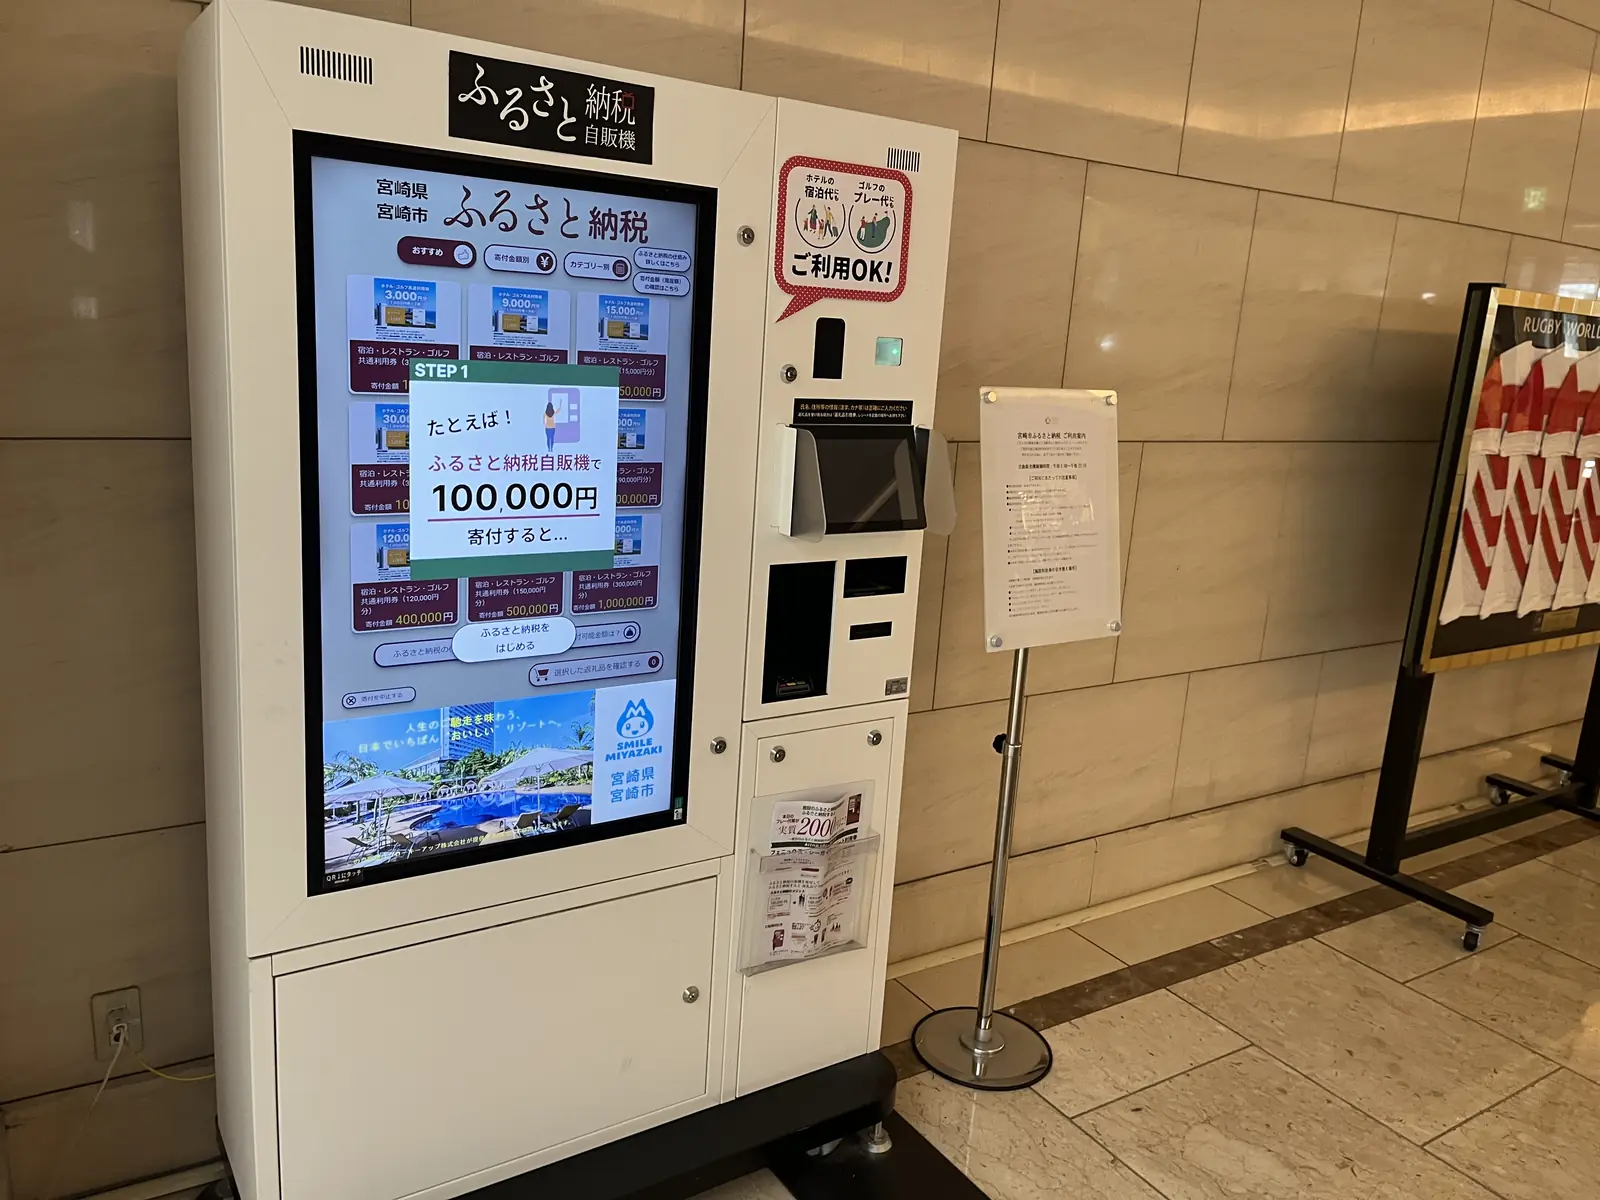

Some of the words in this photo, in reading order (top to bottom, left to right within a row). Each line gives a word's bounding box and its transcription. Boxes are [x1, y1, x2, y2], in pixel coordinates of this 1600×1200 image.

[457, 63, 636, 142] ふるさと納税
[584, 125, 636, 151] 自販機
[805, 174, 834, 185] ホテルの
[858, 181, 886, 192] ゴルフの
[376, 178, 429, 201] 宮崎県
[376, 203, 429, 225] 宮崎市
[443, 184, 649, 245] ふるさと納税
[411, 246, 444, 257] おすすめ
[494, 253, 530, 264] 寄付金額別
[570, 260, 611, 271] カテゴリー別
[1523, 316, 1562, 335] RUGBY
[357, 346, 450, 358] 宿泊・レストラン・ゴルフ
[476, 351, 560, 362] 宿泊・レストラン・ゴルフ
[583, 356, 659, 367] 宿泊・レストラン・ゴルフ
[414, 363, 457, 378] STEP
[460, 364, 468, 379] 1
[370, 382, 400, 390] 寄付金額
[427, 410, 512, 437] たとえば！
[428, 453, 602, 473] ふるさと納税自販機で
[431, 482, 598, 514] 100,000円
[364, 503, 393, 511] 寄付金額
[475, 577, 556, 589] 宿泊・レストラン・ゴルフ
[578, 570, 652, 582] 宿泊・レストラン・ゴルフ
[360, 583, 450, 596] 宿泊・レストラン・ゴルフ
[478, 611, 504, 619] 寄付金額
[506, 603, 559, 617] 500,000円
[573, 603, 596, 611] 寄付金額
[598, 596, 654, 609] 1,000,000円
[365, 619, 393, 628] 寄付金額
[395, 611, 454, 626] 400,000円
[480, 623, 550, 639] ふるさと納税を
[392, 643, 452, 659] ふるさと納税の
[496, 640, 536, 654] はじめる
[554, 659, 641, 677] 選択した返礼品を確認する
[616, 737, 654, 751] SMILE
[605, 746, 663, 762] MIYAZAKI
[610, 765, 655, 785] 宮崎県
[610, 783, 655, 804] 宮崎市
